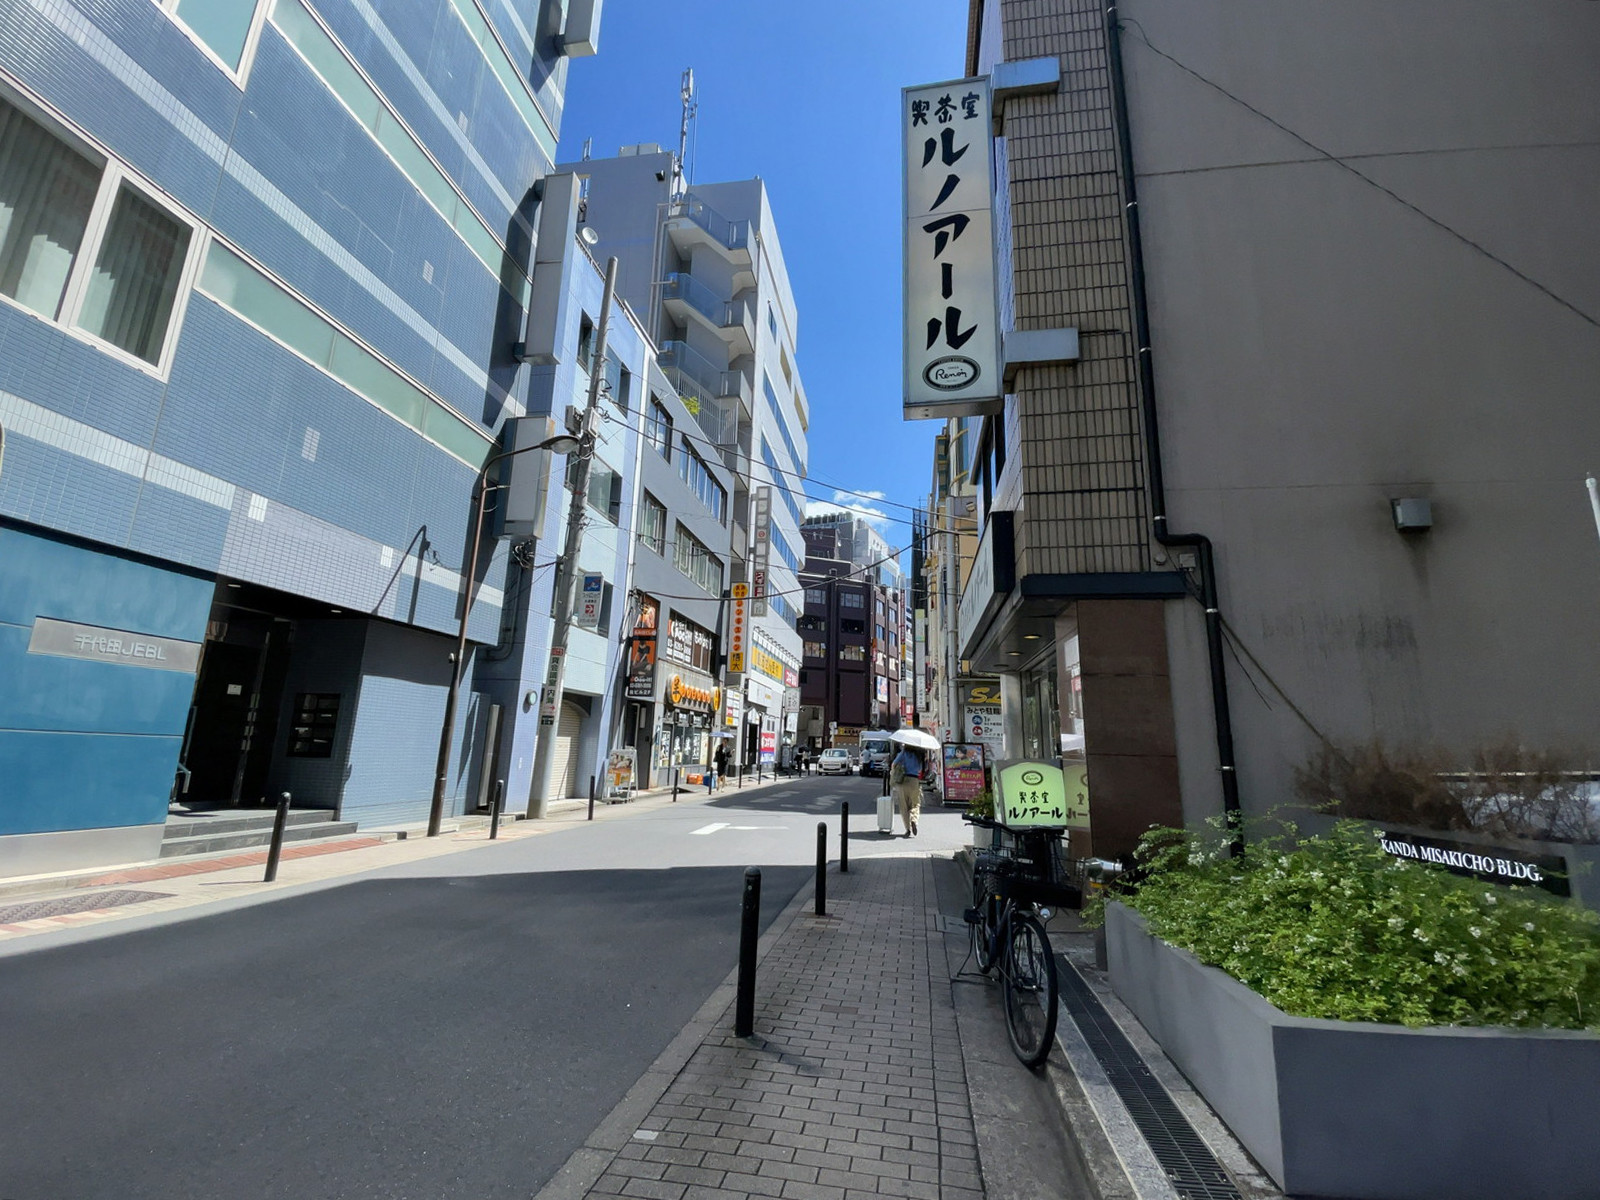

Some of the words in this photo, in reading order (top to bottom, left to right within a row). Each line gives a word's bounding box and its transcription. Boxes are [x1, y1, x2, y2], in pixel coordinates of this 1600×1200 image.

[911, 91, 980, 127] 喫茶室
[922, 127, 979, 350] ルノアール
[74, 633, 167, 661] 千代田JEBL
[1008, 806, 1063, 820] ルノアール
[1019, 791, 1049, 804] 喫茶室
[1380, 839, 1418, 859] KANDA
[1419, 846, 1495, 873] MISAKICHO
[1497, 859, 1544, 882] BLDG.
